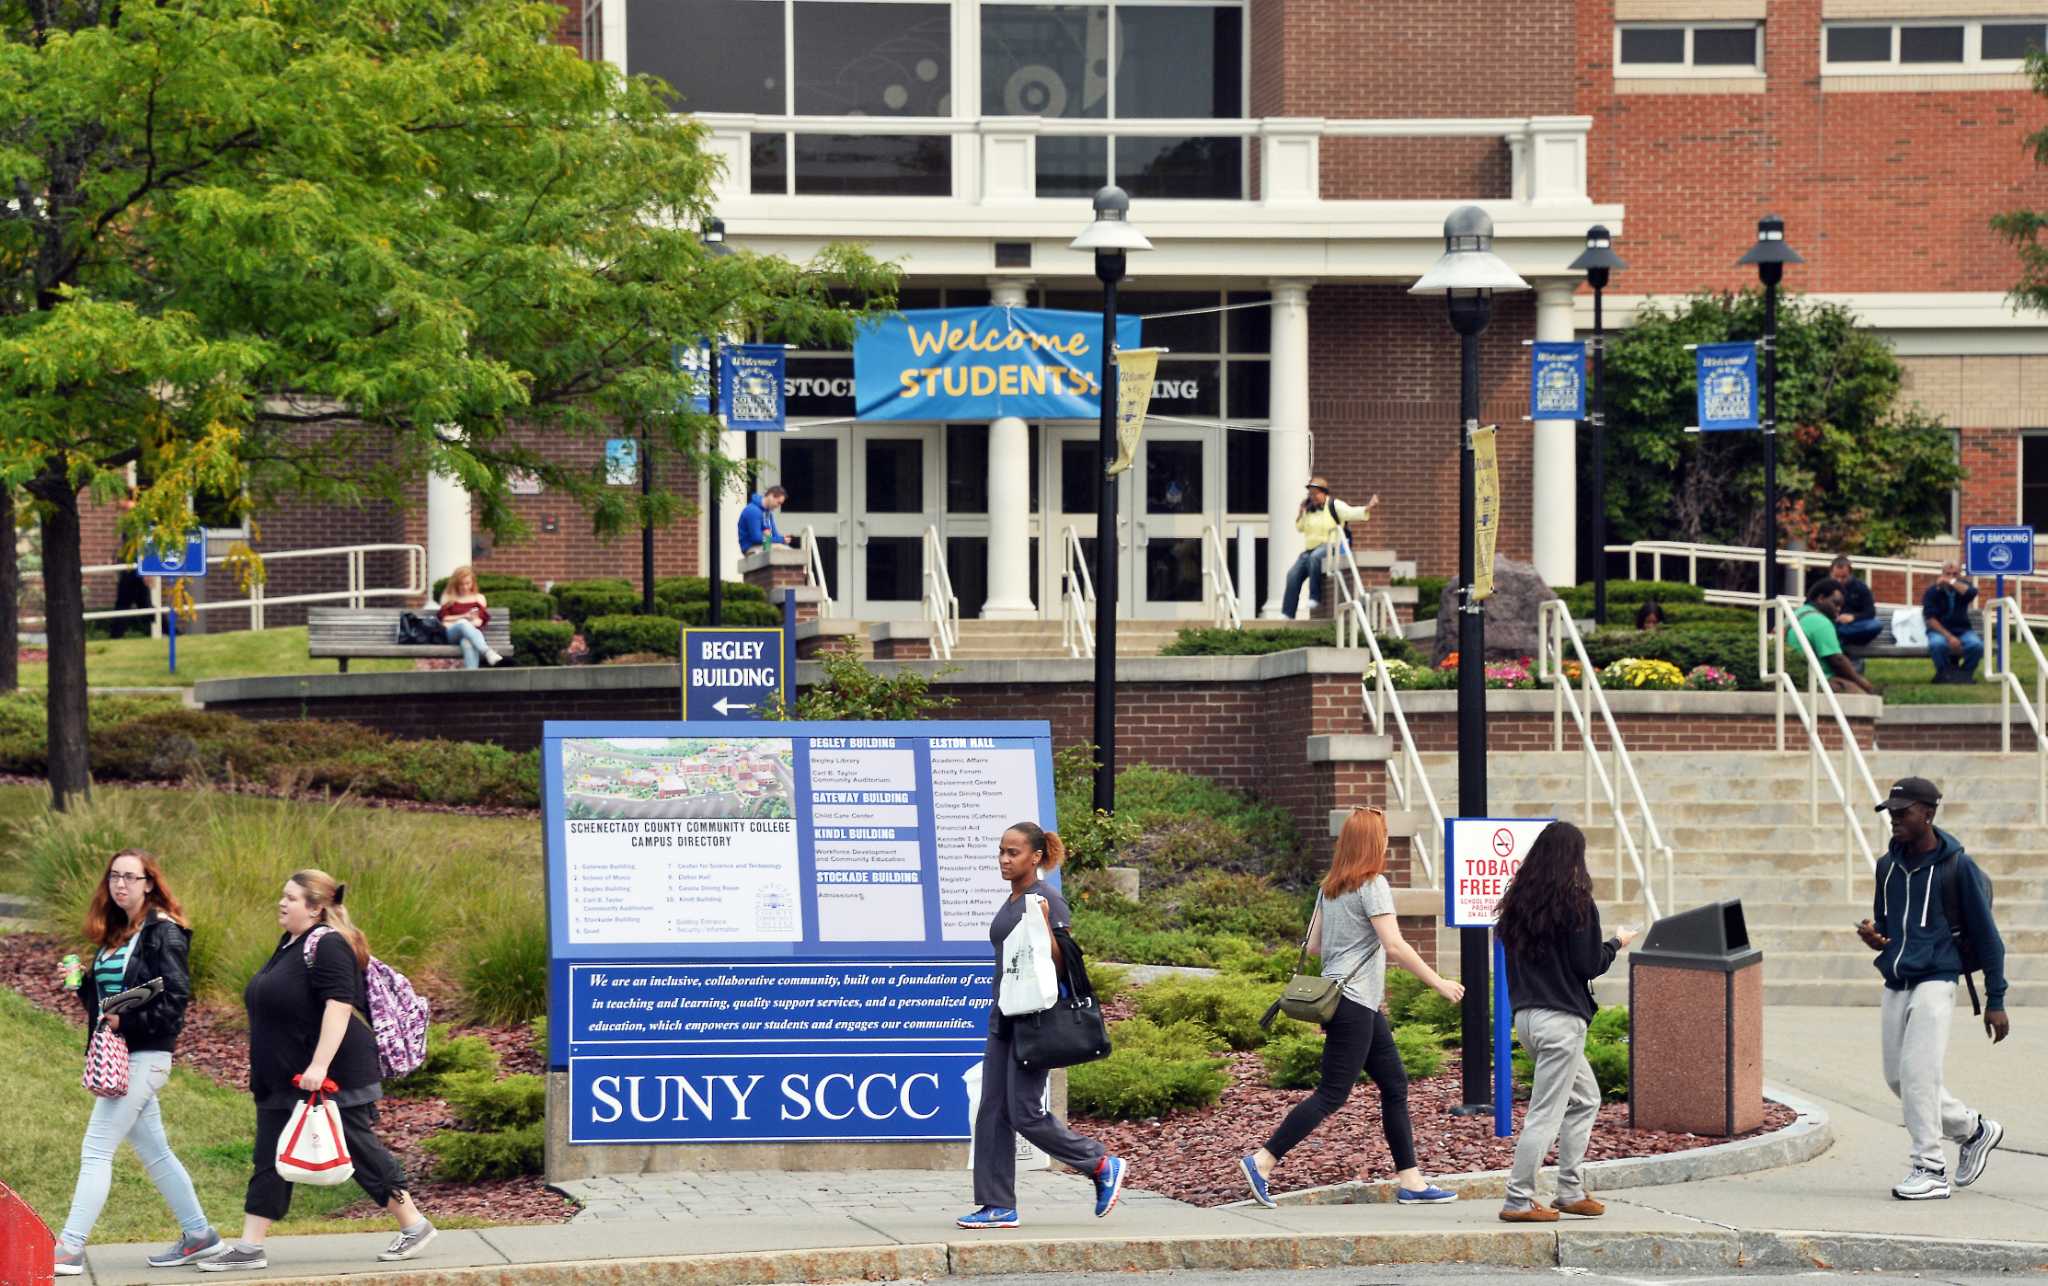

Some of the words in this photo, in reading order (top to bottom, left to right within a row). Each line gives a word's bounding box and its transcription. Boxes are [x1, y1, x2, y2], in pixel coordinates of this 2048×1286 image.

[908, 319, 1090, 357] Welcome
[784, 377, 856, 397] STOC
[1152, 380, 1199, 399] ING
[899, 364, 1101, 398] STUDENTS!
[1972, 534, 1985, 544] NO
[1987, 533, 2029, 544] SMOKING
[702, 641, 764, 660] BEGLEY
[692, 667, 775, 687] BUILDING
[810, 738, 846, 748] BEGLEY
[849, 738, 896, 748] BUILDING
[929, 738, 967, 748] ELSTON
[970, 738, 995, 748] HALL
[812, 792, 859, 803] GATEWAY
[862, 792, 909, 803] BUILDING
[571, 822, 639, 834] SCHENECTADY
[644, 822, 682, 833] COUNTY
[687, 821, 745, 833] COMMUNITY
[750, 821, 791, 832] COLLEGE
[814, 828, 847, 839] KINDL
[848, 828, 895, 839] BUILDING
[631, 836, 672, 847] CAMPUS
[677, 836, 732, 847] DIRECTORY
[1465, 860, 1520, 877] TOBAC
[816, 871, 869, 882] STOCKADE
[871, 871, 919, 882] BUILDING
[1460, 879, 1501, 895] FREE
[590, 973, 608, 987] We
[611, 978, 630, 986] are
[632, 978, 647, 986] an
[650, 975, 702, 988] inclusive,
[704, 974, 775, 986] collaborative
[777, 974, 841, 987] community,
[843, 974, 869, 985] built
[871, 977, 886, 985] on
[888, 977, 895, 985] a
[896, 974, 957, 987] foundation
[959, 974, 974, 986] of
[974, 976, 993, 984] exc
[592, 999, 604, 1009] in
[607, 998, 654, 1011] teaching
[657, 997, 679, 1008] and
[680, 997, 730, 1010] learning,
[733, 997, 771, 1010] quality
[773, 998, 815, 1010] support
[817, 997, 862, 1008] services,
[865, 996, 887, 1007] and
[889, 999, 896, 1007] a
[897, 996, 967, 1008] personalized
[968, 999, 994, 1009] appr
[588, 1020, 646, 1032] education,
[649, 1019, 682, 1031] which
[685, 1021, 739, 1032] empowers
[742, 1022, 763, 1030] our
[764, 1019, 809, 1030] students
[811, 1018, 833, 1029] and
[835, 1021, 879, 1031] engages
[881, 1021, 901, 1029] our
[903, 1018, 975, 1029] communities.
[591, 1074, 765, 1122] SUNY
[781, 1073, 940, 1121] SCCC
